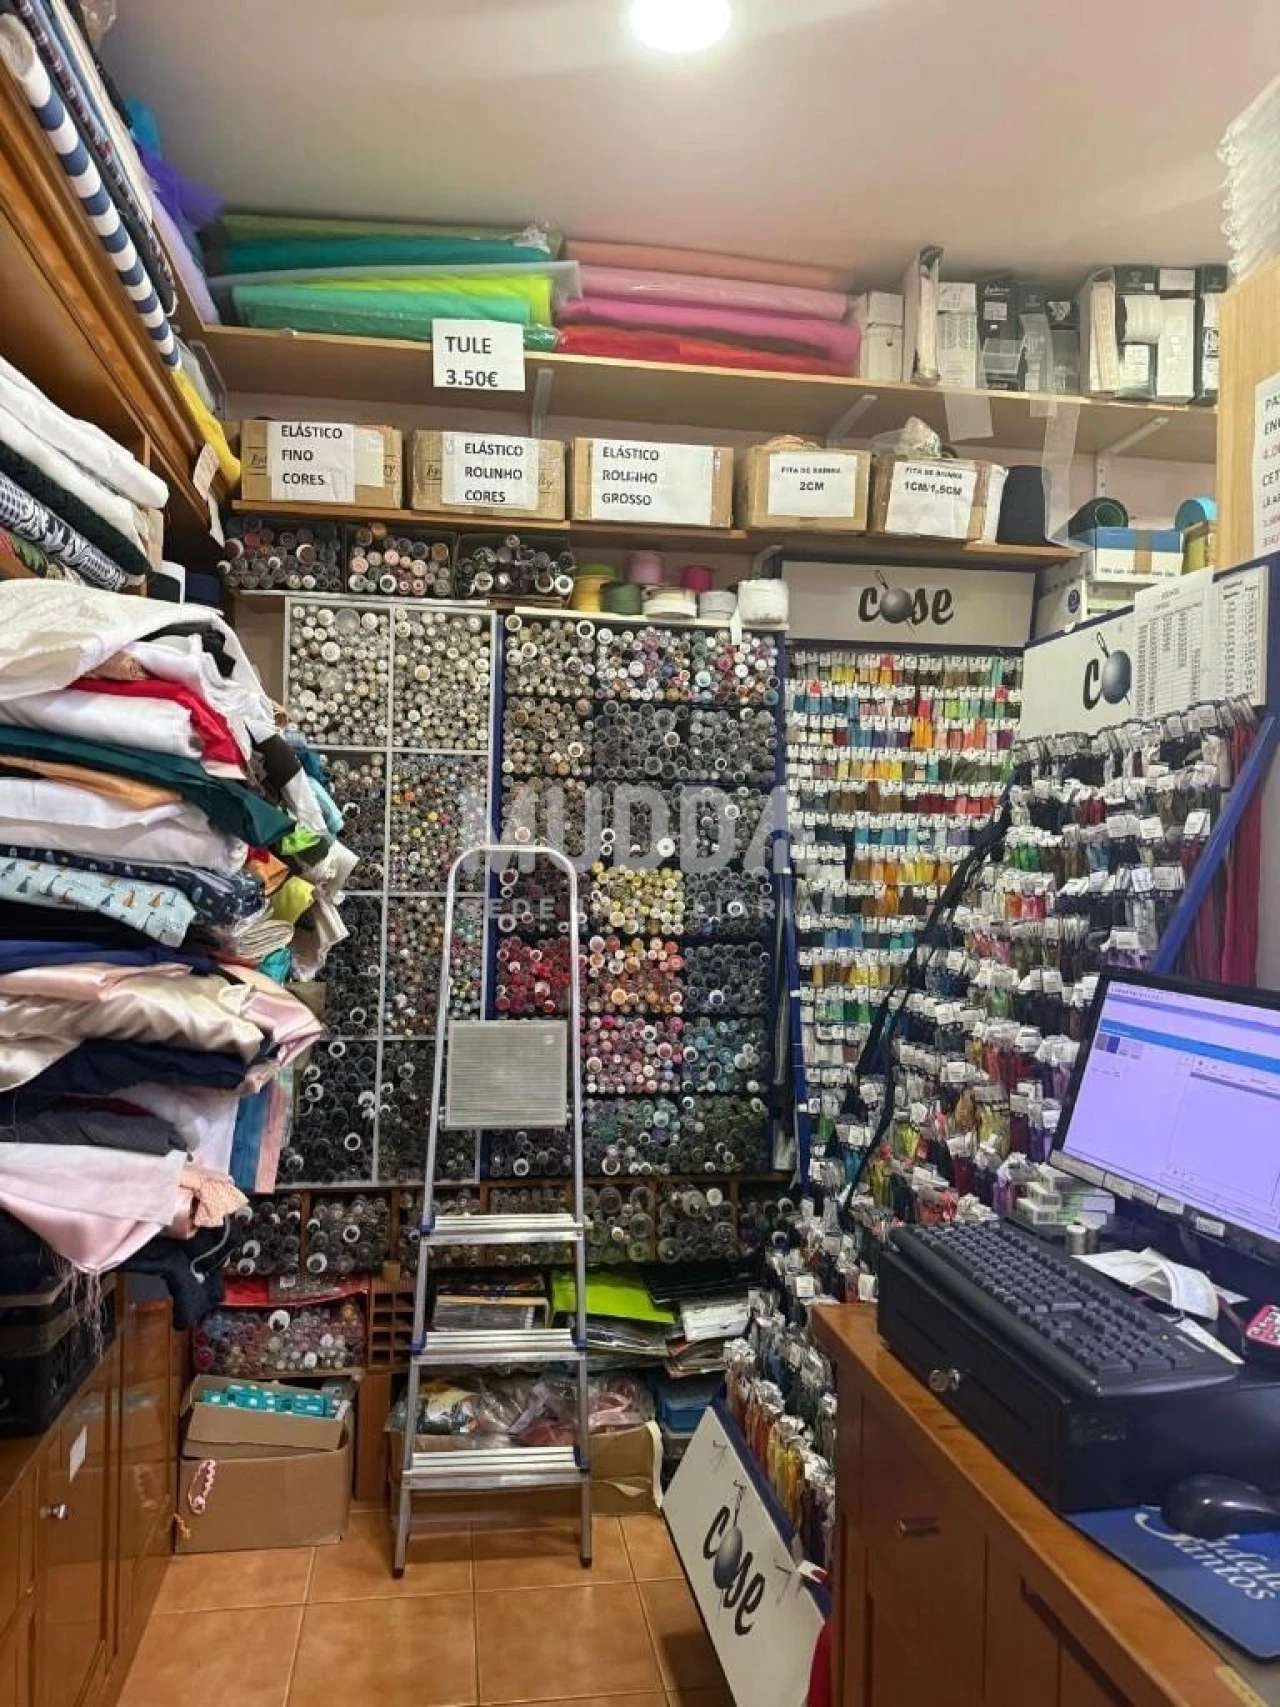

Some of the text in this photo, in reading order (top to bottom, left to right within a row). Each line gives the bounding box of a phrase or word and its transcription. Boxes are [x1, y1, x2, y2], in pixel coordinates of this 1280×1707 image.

[444, 336, 492, 354] TULE
[446, 370, 499, 388] 3.50€
[281, 423, 343, 440] ELÁSTICO
[464, 440, 524, 457] ELÁSTICO
[602, 444, 660, 461] ELÁSTICO
[281, 450, 314, 462] FINO
[464, 466, 523, 480] ROLINHO
[602, 469, 658, 484] ROLINHO
[781, 466, 799, 474] FITA
[905, 466, 923, 476] FITA
[282, 473, 325, 487] CORES
[799, 481, 825, 491] 2CM
[464, 489, 507, 503] CORES
[601, 493, 652, 506] GROSSO
